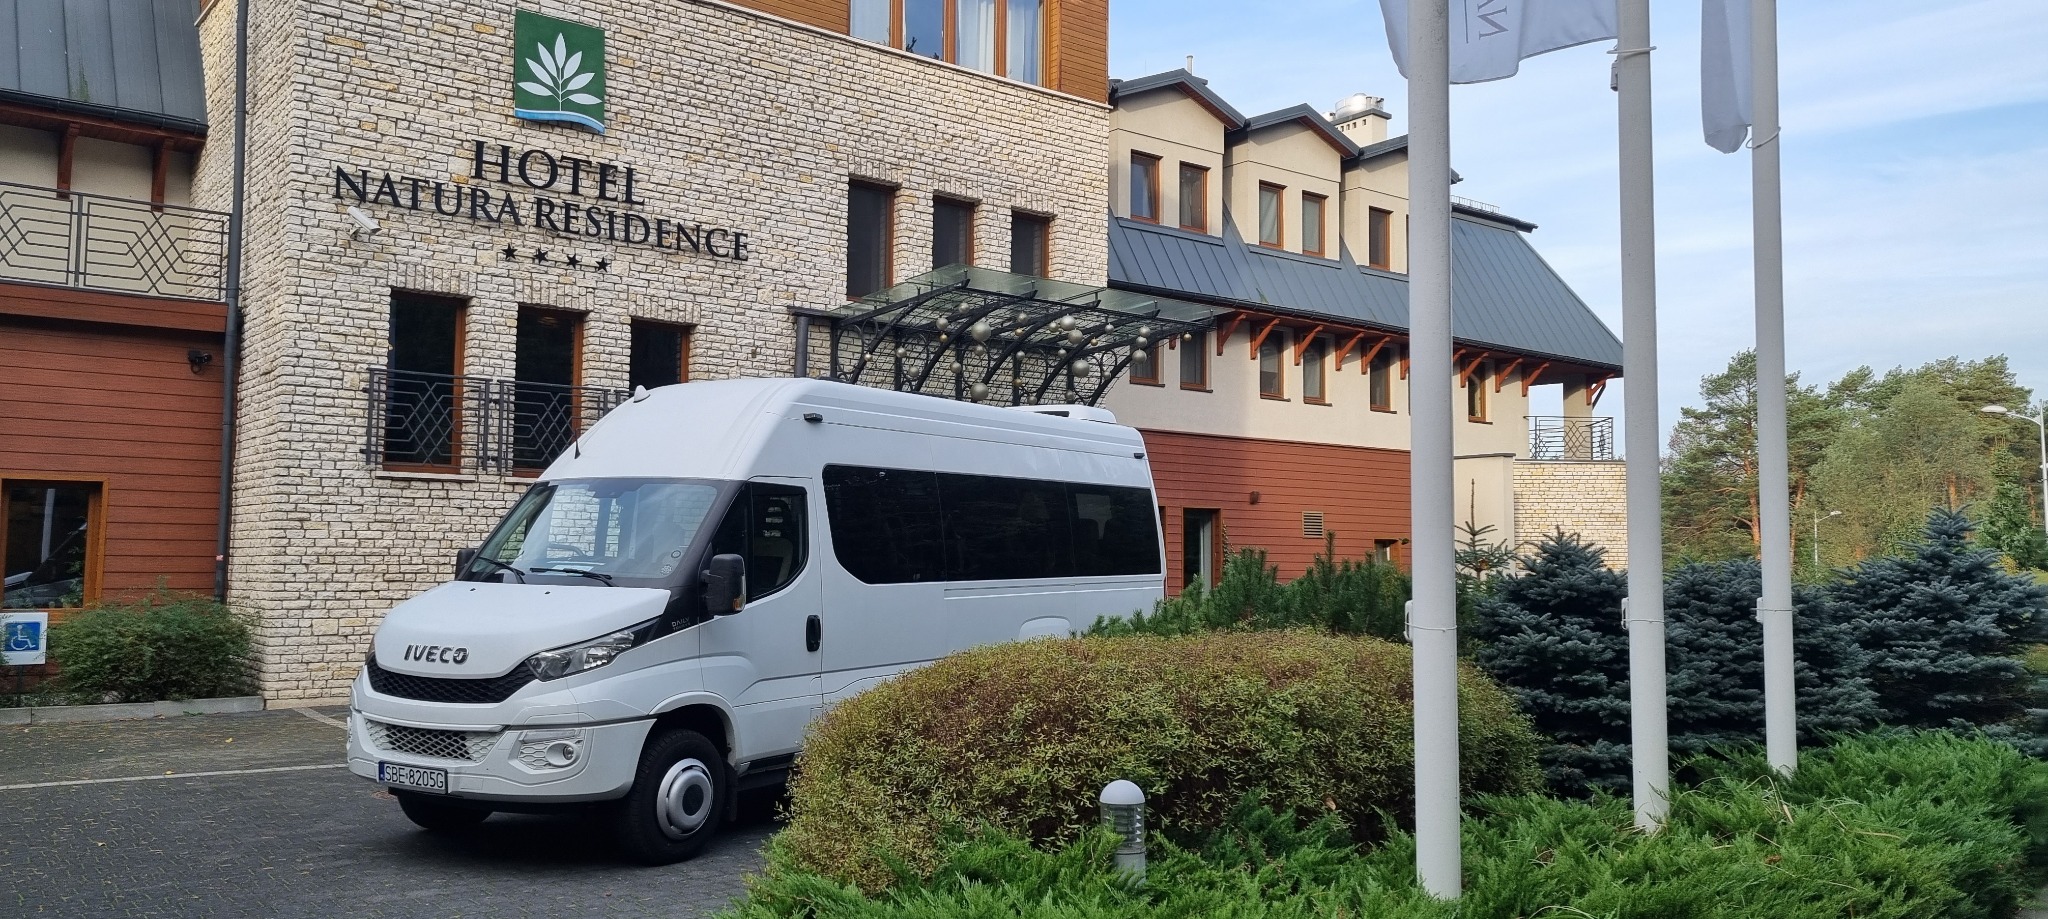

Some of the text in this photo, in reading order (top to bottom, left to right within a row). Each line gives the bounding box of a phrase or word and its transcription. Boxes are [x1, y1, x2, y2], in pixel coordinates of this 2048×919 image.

[471, 139, 645, 206] HOTEL
[335, 165, 749, 262] NATURA RESIDENCE
[404, 644, 469, 666] IVECO
